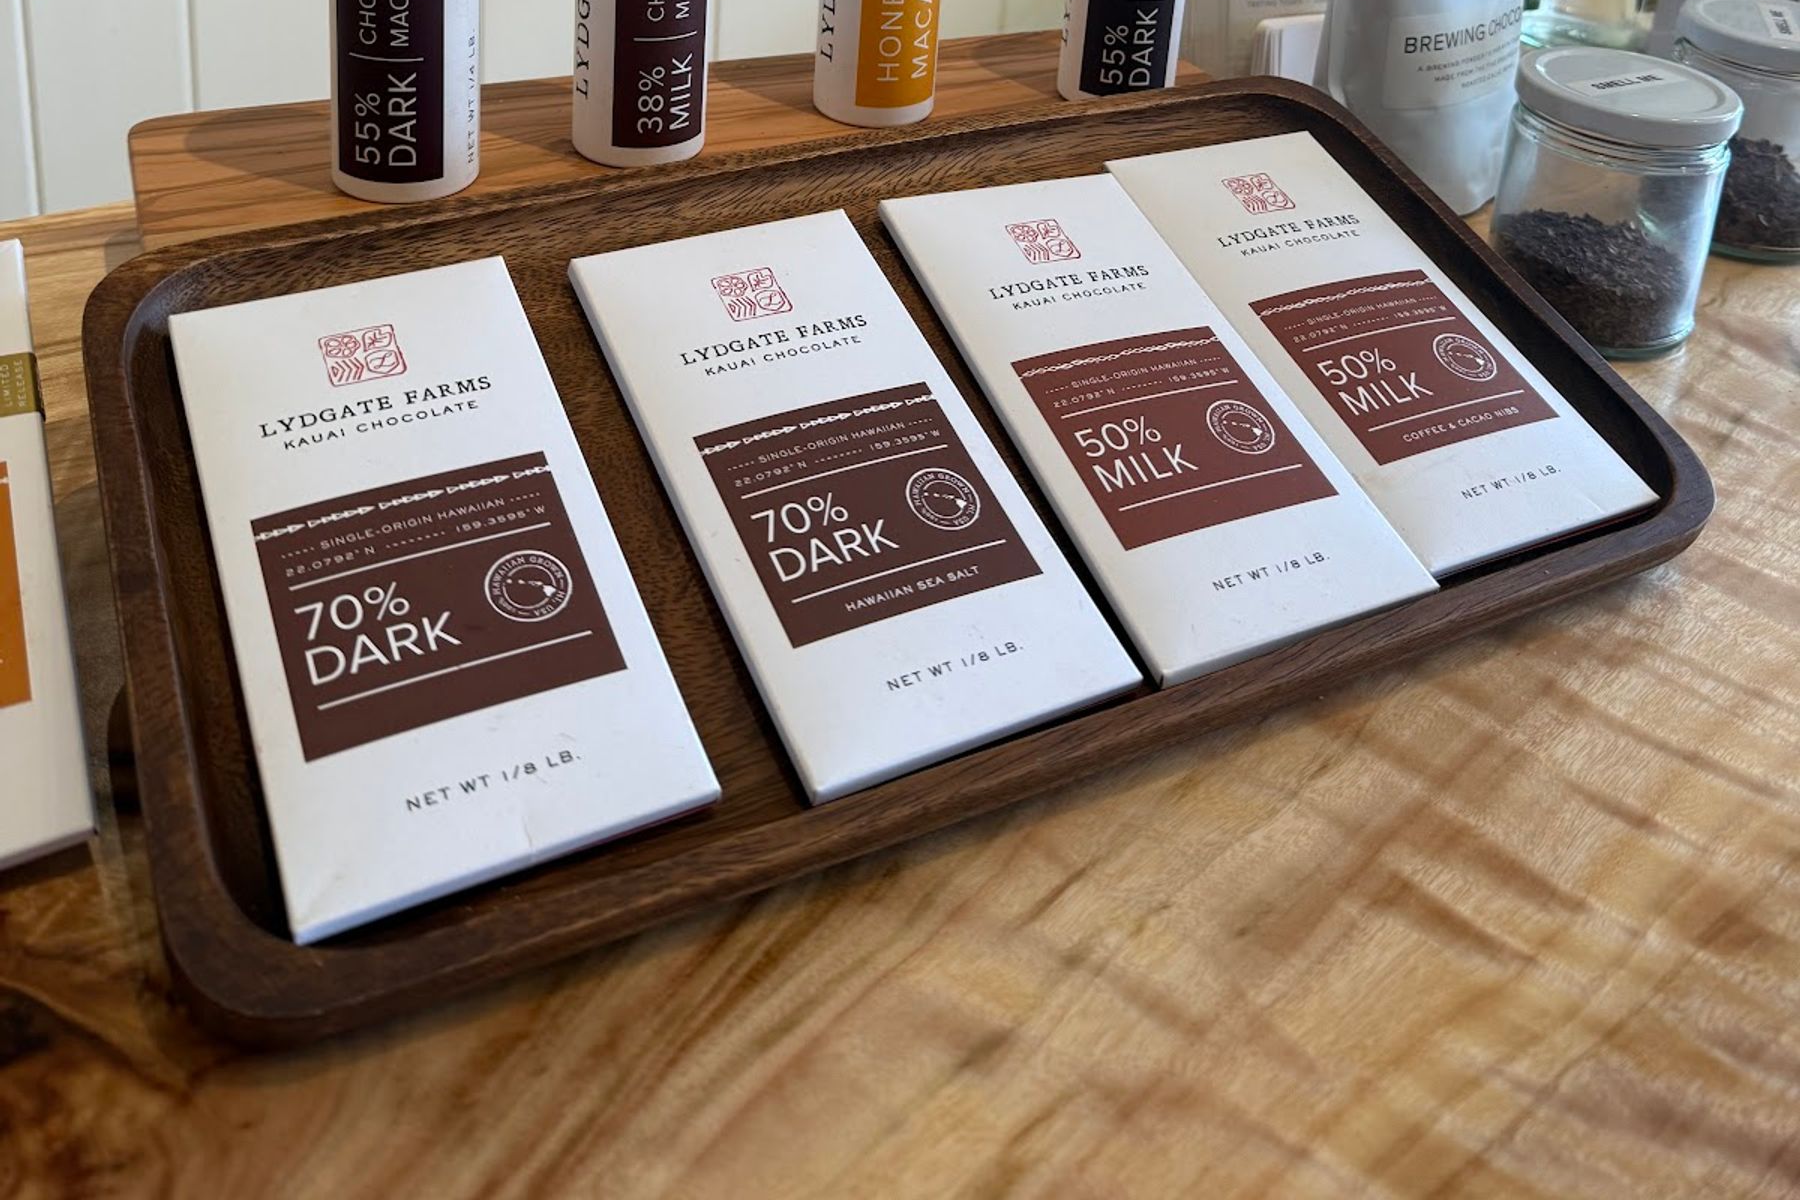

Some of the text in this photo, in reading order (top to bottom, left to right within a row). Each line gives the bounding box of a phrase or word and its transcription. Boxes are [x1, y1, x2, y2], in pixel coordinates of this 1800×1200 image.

[1100, 24, 1129, 86] 55%
[1128, 7, 1159, 88] DARK
[1404, 24, 1486, 54] BREWING
[637, 65, 666, 134] 38%
[669, 52, 693, 131] MILK
[1591, 74, 1664, 89] SMELL ME
[355, 92, 381, 165] 55%
[388, 73, 417, 167] DARK
[1217, 214, 1361, 248] LYDGATE FARMS
[1240, 229, 1361, 256] KAUAI CHOCOLATE
[988, 265, 1150, 300] LYDGATE FARMS
[1012, 281, 1147, 311] KAUAI CHOCOLATE
[680, 314, 868, 366] LYDGATE FARMS
[705, 335, 862, 376] KAUAI CHOCOLATE
[1071, 367, 1149, 388] SINGLE-ORIGIN
[1316, 348, 1397, 386] 50%
[258, 376, 492, 438] LYDGATE FARMS
[1338, 371, 1434, 416] MILK
[283, 400, 479, 450] KAUAI CHOCOLATE
[758, 421, 906, 463] SINGLE-ORIGIN HAWAIIAN
[1073, 415, 1162, 458] 50%
[1402, 406, 1520, 443] COFFEE & CACAO NIBS
[796, 461, 808, 469] N
[1092, 443, 1199, 494] MILK
[1461, 464, 1562, 500] NET WT 1/8 LB.
[320, 498, 505, 550] SINGLE-ORIGIN HAWAIIAN
[364, 545, 376, 555] N
[533, 505, 545, 514] W
[751, 492, 848, 543] 70%
[768, 518, 900, 583] DARK
[1212, 551, 1330, 591] NET WT 1/8 LB.
[294, 581, 411, 641] 70%
[845, 565, 980, 612] HAWAIIAN SEA SALT
[304, 611, 463, 686] DARK
[886, 641, 1024, 691] NET WT 1/8 LB.
[406, 750, 581, 812] NET WT 1/8 LB.
